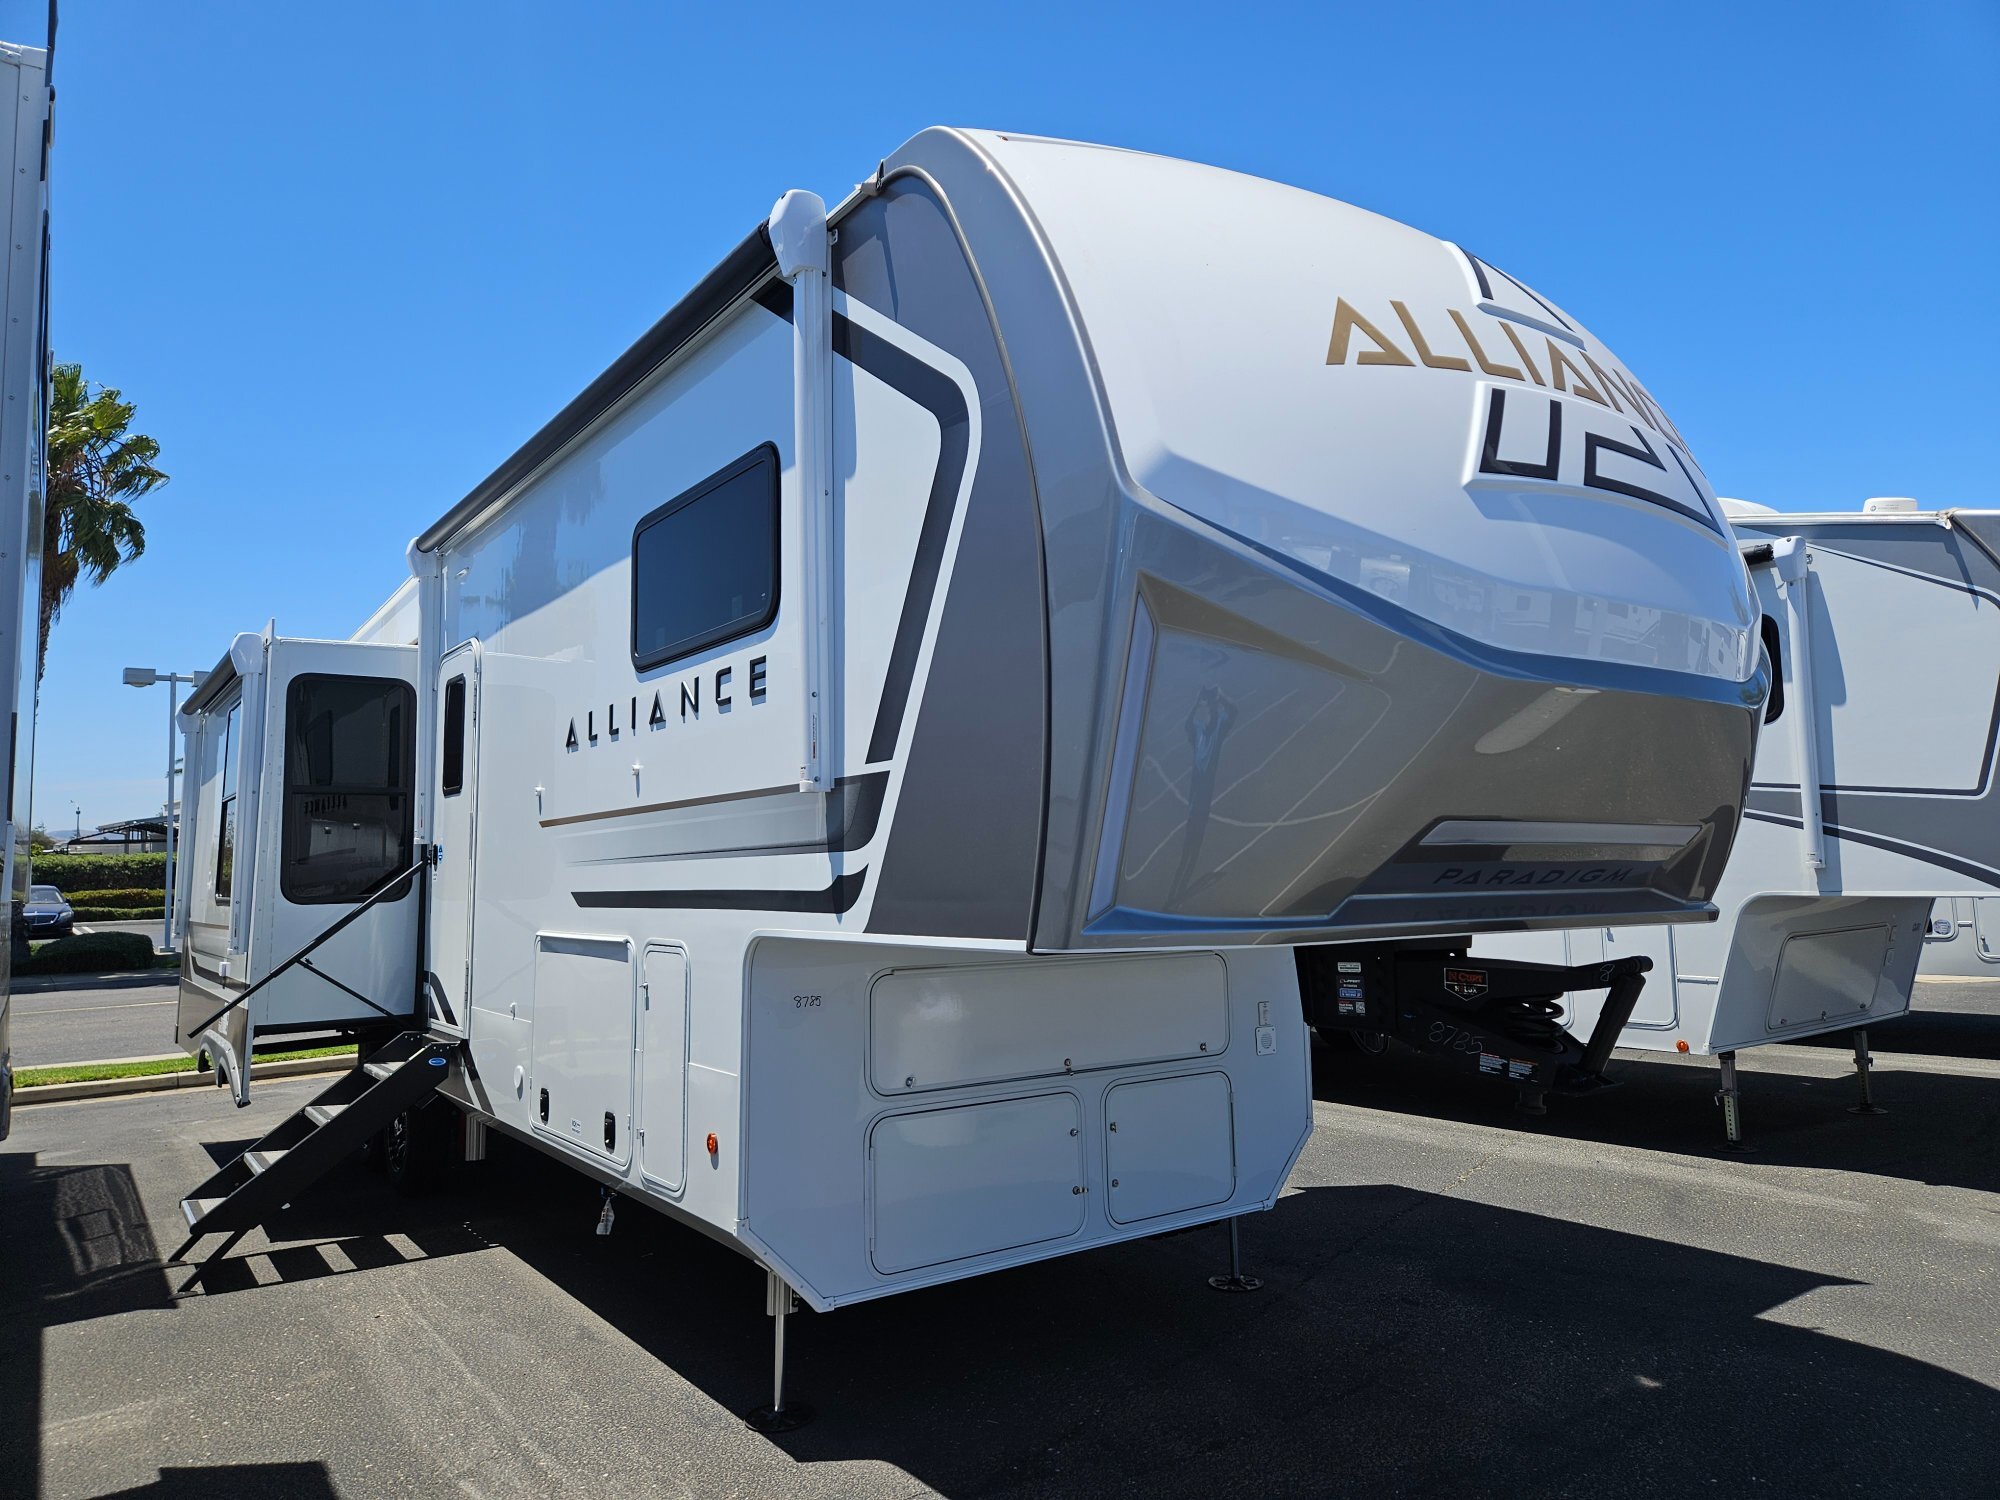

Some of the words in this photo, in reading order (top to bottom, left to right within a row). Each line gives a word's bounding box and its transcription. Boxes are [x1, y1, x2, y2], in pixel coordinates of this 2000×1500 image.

[565, 654, 767, 748] ALLIANCE
[1432, 867, 1634, 885] PARADIGM
[793, 995, 822, 1009] 8785
[1428, 1021, 1487, 1055] 8785
